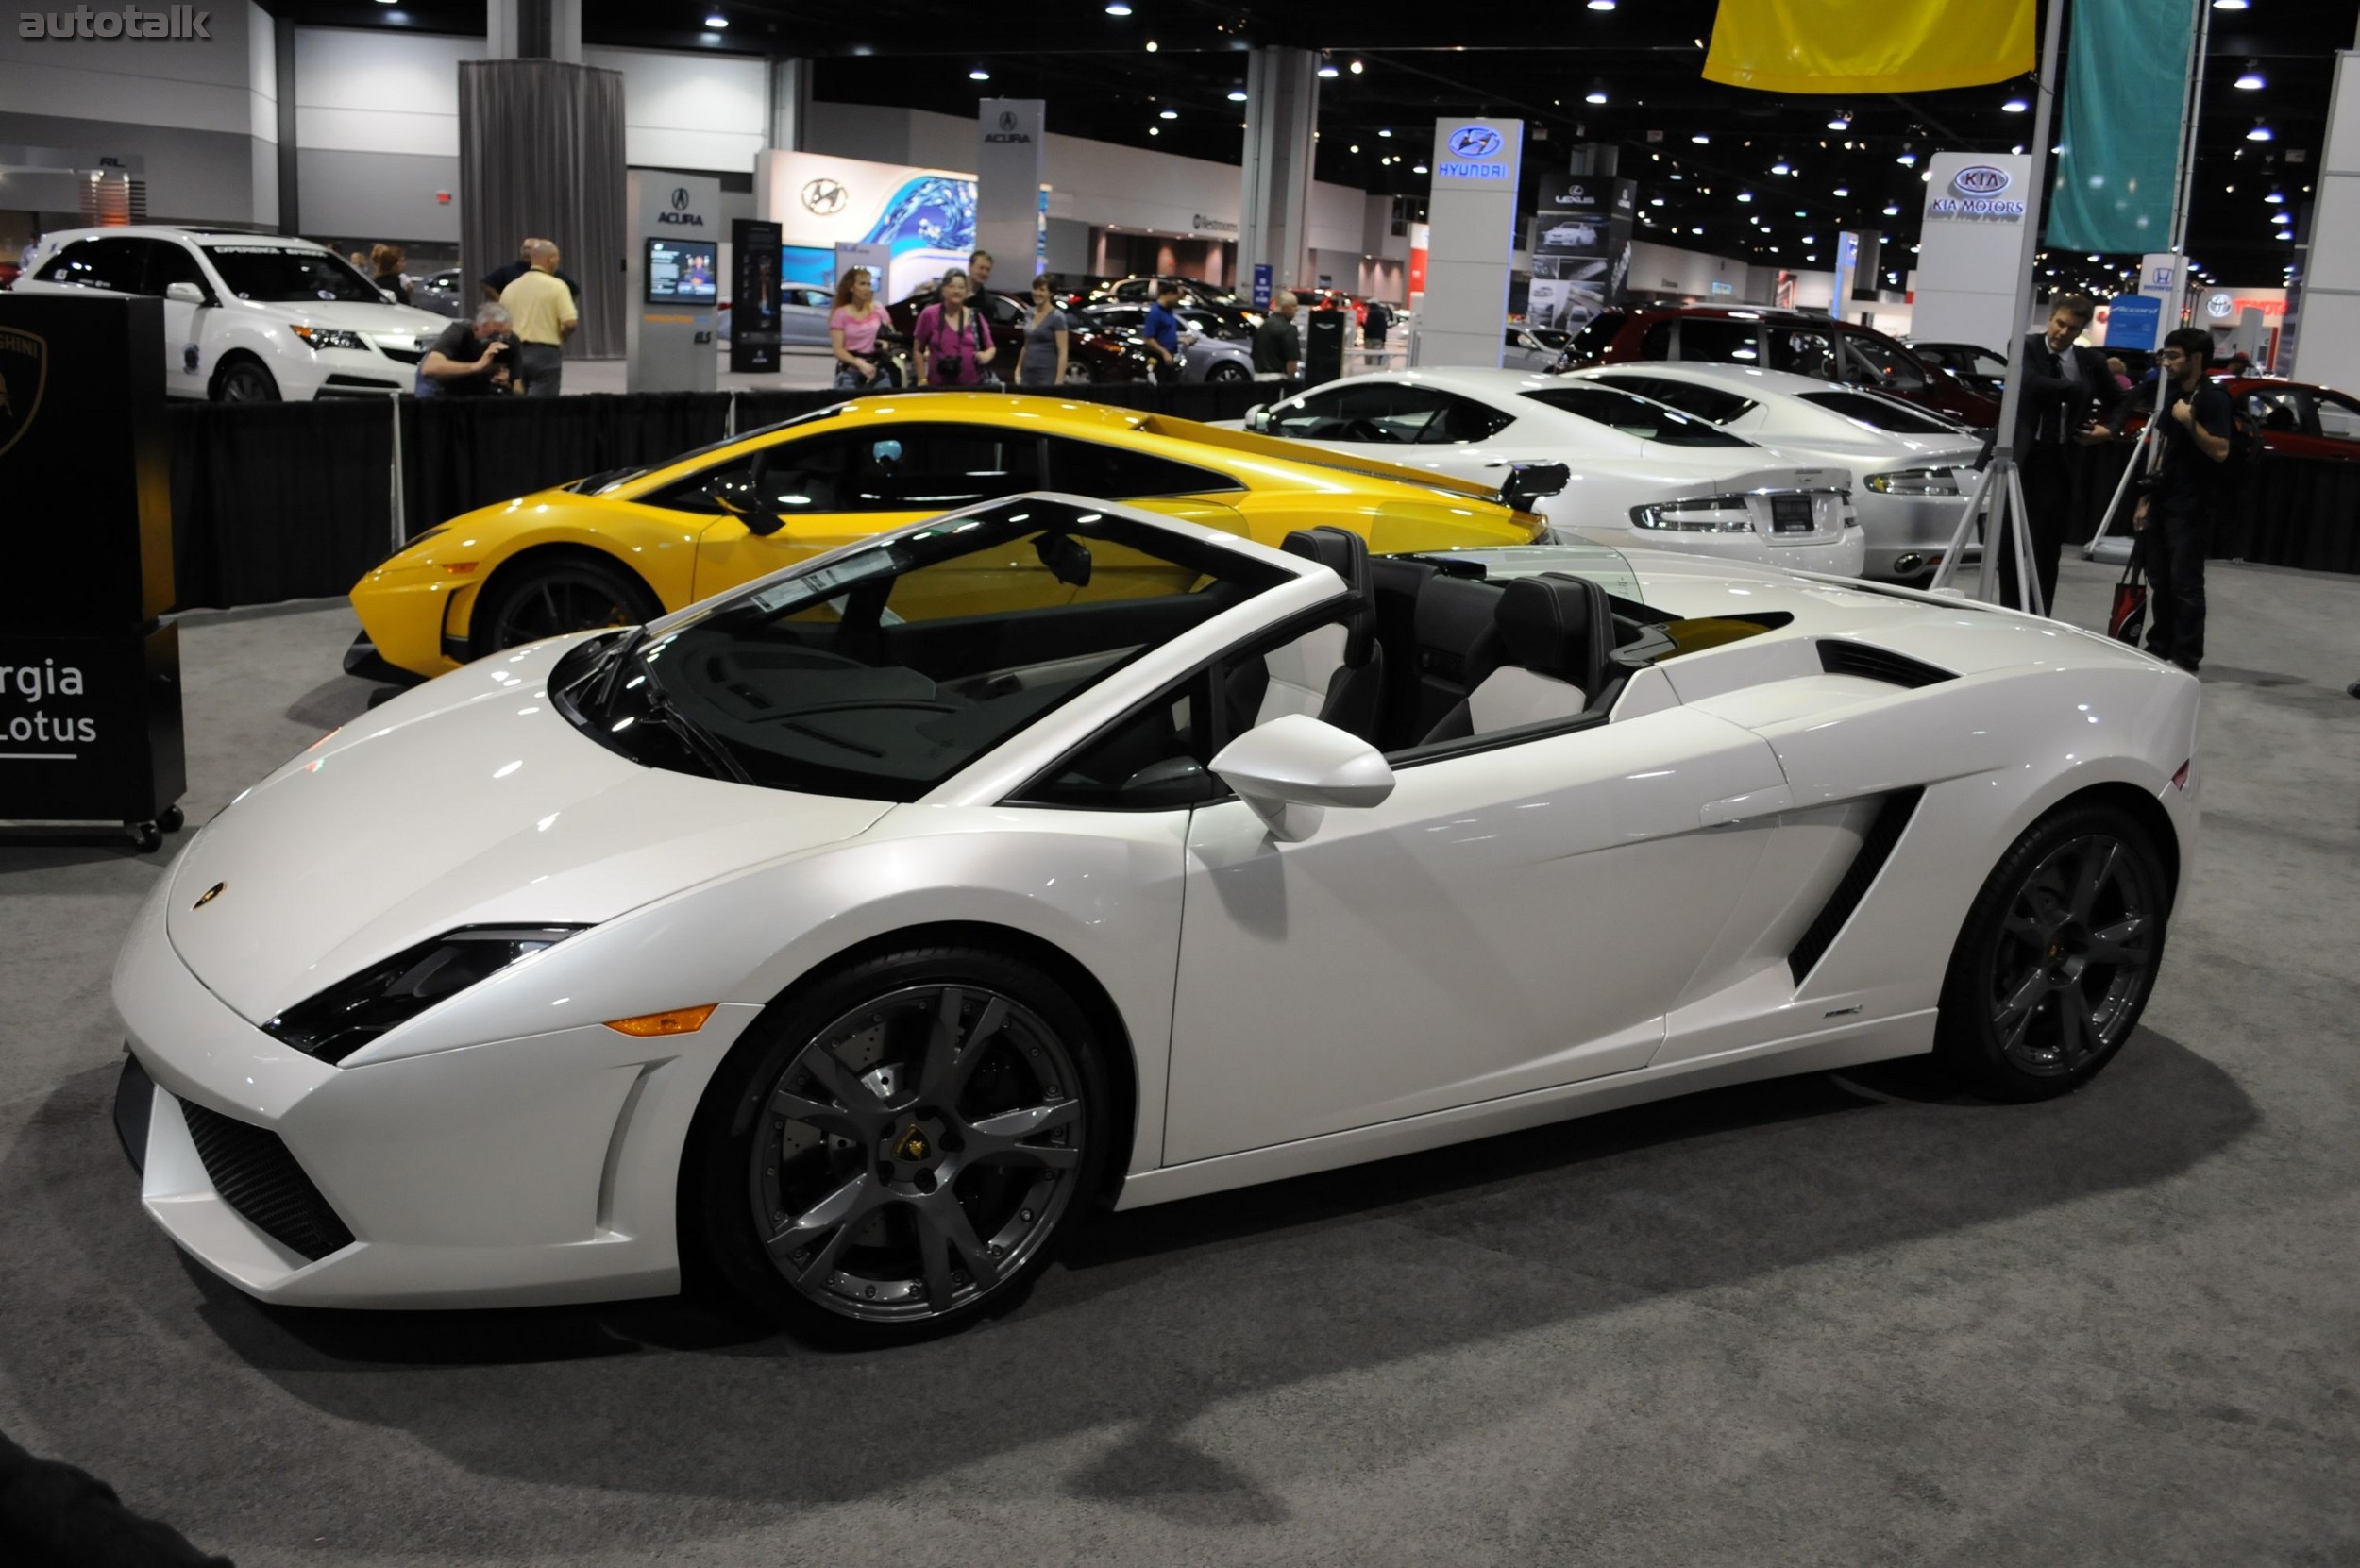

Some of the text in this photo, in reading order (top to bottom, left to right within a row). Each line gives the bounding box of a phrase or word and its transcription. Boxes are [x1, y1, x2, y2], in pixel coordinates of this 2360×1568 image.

[1439, 162, 1506, 177] HYUNDAI
[1964, 172, 1998, 186] KIA
[1555, 195, 1595, 205] LEXUS
[1933, 199, 2024, 214] KIA MOTORS
[658, 211, 704, 227] ACURA
[0, 657, 84, 703] rgia
